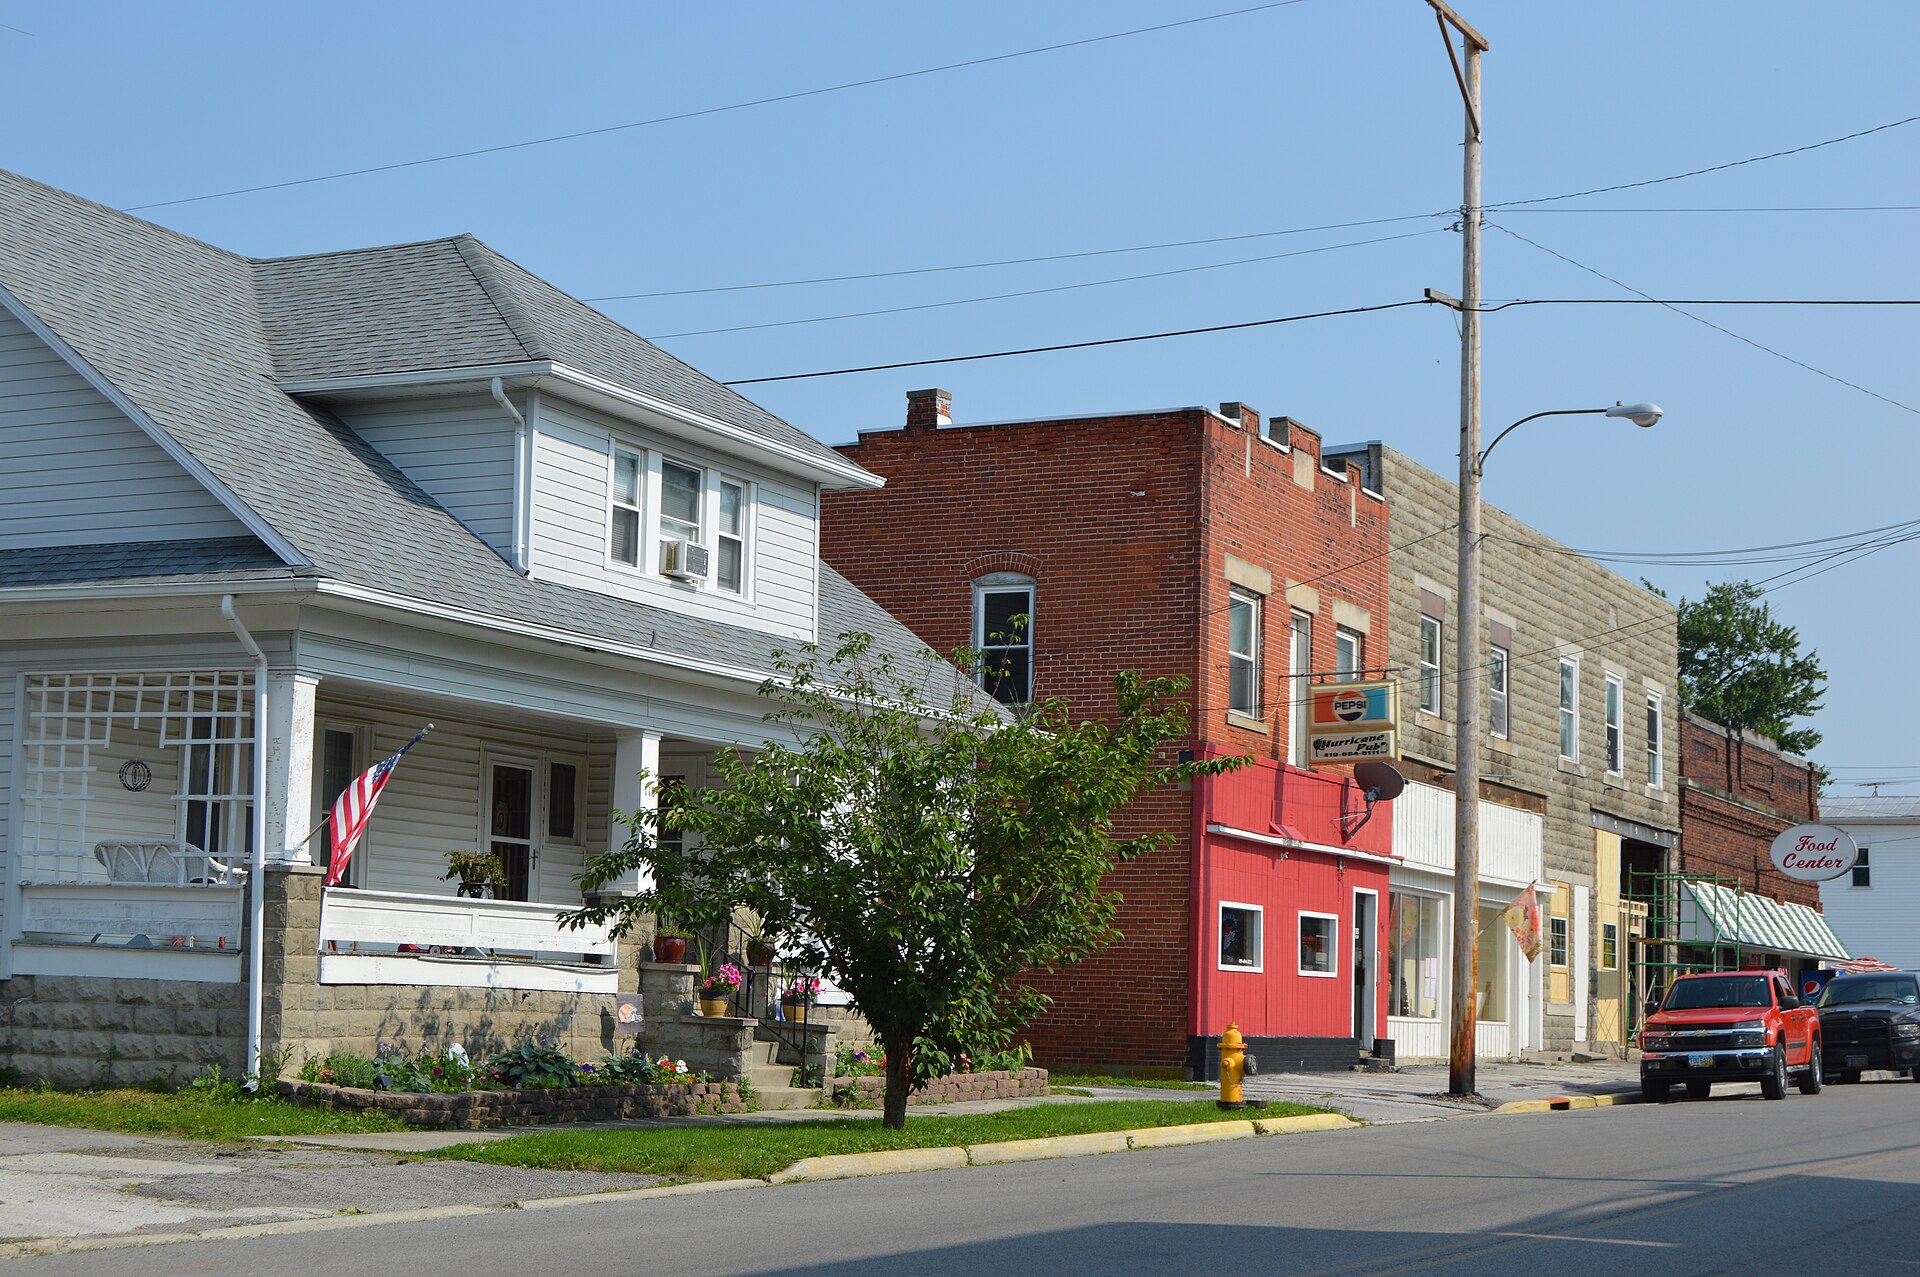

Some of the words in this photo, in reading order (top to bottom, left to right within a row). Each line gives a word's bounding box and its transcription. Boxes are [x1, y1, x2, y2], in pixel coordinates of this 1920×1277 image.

[1334, 701, 1366, 710] PEPSI
[1321, 735, 1384, 748] Hurricane
[1795, 835, 1839, 851] Food
[1782, 853, 1843, 868] Center
